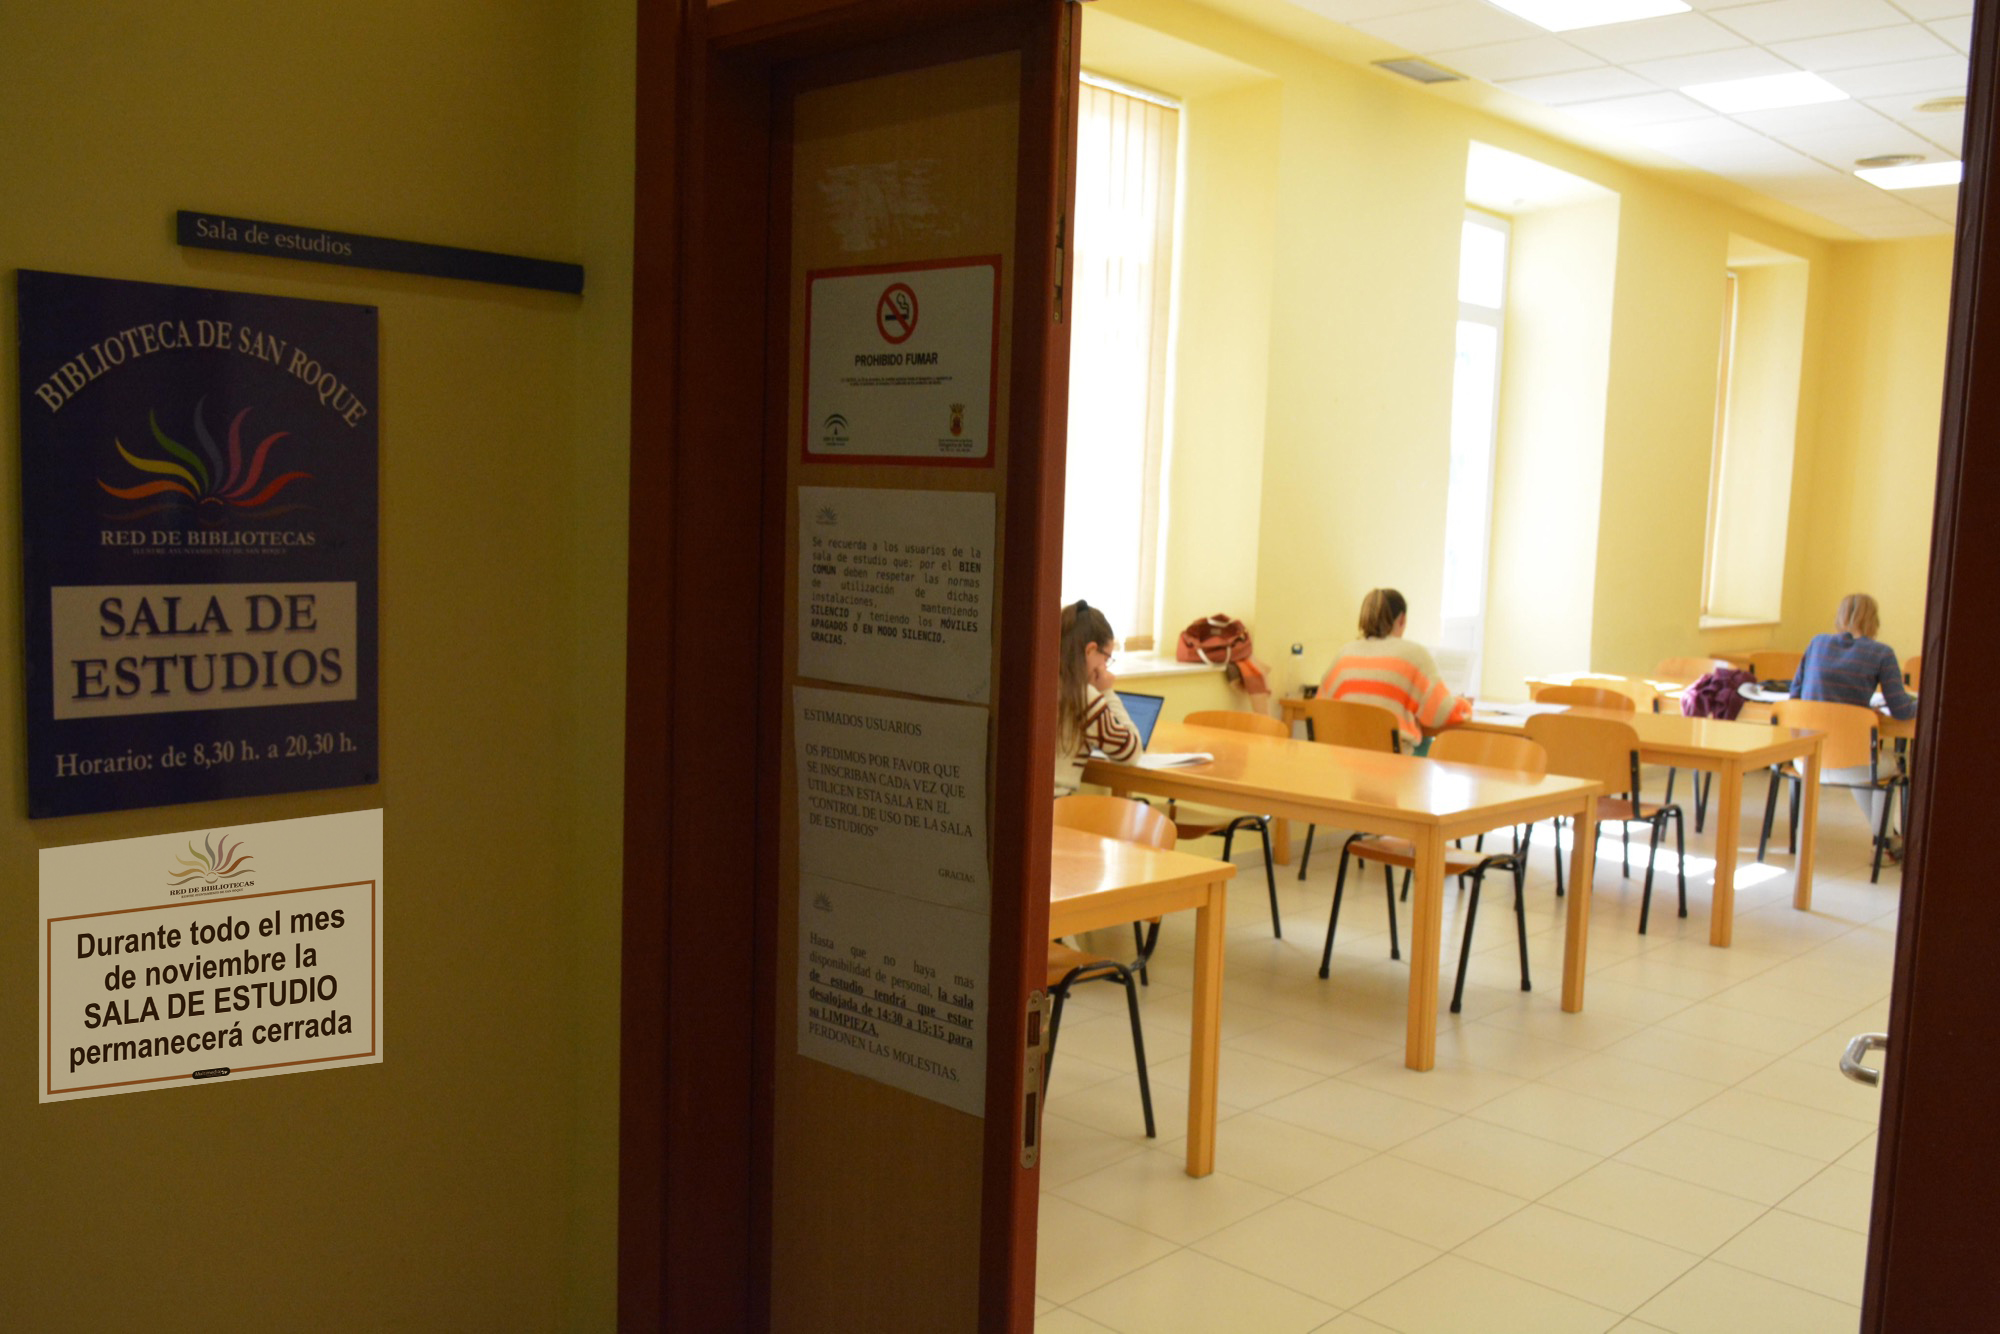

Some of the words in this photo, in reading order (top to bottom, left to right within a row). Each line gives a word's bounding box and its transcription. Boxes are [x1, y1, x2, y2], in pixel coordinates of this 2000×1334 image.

[196, 218, 237, 241] Sala
[245, 225, 269, 245] de
[275, 226, 352, 256] estudios
[35, 319, 193, 413] BIBLIOTECA
[199, 319, 233, 349] DE
[239, 326, 286, 365] SAN
[288, 348, 367, 427] ROQUE
[855, 354, 903, 366] PROHIBIDO
[906, 353, 938, 365] FUMAR
[101, 531, 146, 545] RED
[152, 531, 181, 545] DE
[187, 531, 316, 546] BIBLIOTECAS
[813, 537, 822, 546] Se
[829, 539, 866, 550] recuerda
[884, 541, 898, 553] los
[905, 544, 945, 556] usuarios
[952, 547, 963, 558] de
[971, 547, 980, 558] la
[812, 552, 831, 561] sala
[837, 553, 847, 562] de
[853, 554, 887, 565] estudio
[920, 561, 935, 570] por
[942, 560, 951, 570] el
[959, 562, 981, 573] BIEN
[844, 568, 867, 578] deben
[876, 570, 915, 582] respetar
[924, 573, 939, 584] las
[948, 576, 979, 588] normas
[812, 578, 821, 588] de
[841, 580, 894, 594] utilización
[915, 588, 926, 598] de
[947, 591, 979, 603] dichas
[99, 596, 232, 638] SALA
[246, 593, 317, 633] DE
[811, 606, 849, 617] SILENCIO
[857, 612, 862, 621] y
[870, 611, 909, 624] teniendo
[918, 616, 932, 627] los
[921, 603, 978, 617] manteniendo
[811, 619, 848, 631] APAGADOS
[853, 624, 857, 632] O
[863, 624, 872, 634] EN
[878, 626, 897, 637] MODO
[902, 628, 946, 643] SILENCIO.
[811, 632, 846, 645] GRACIAS.
[71, 646, 342, 700] ESTUDIOS
[804, 709, 863, 727] ESTIMADOS
[865, 718, 921, 736] USUARIOS
[56, 750, 153, 778] Horario:
[161, 746, 186, 769] de
[194, 741, 234, 767] 8,30
[241, 739, 260, 761] h.
[268, 744, 279, 759] a
[285, 733, 334, 760] 20,30
[340, 732, 357, 753] h.
[805, 744, 818, 756] OS
[821, 746, 866, 764] PEDIMOS
[869, 754, 889, 768] POR
[893, 757, 930, 774] FAVOR
[933, 763, 960, 778] QUE
[807, 761, 818, 773] SE
[821, 763, 876, 784] INSCRIBAN
[879, 773, 910, 790] CADA
[914, 779, 936, 794] VEZ
[940, 784, 965, 798] QUE
[808, 778, 854, 797] UTILICEN
[857, 789, 882, 803] ESTA
[885, 793, 913, 809] SALA
[917, 799, 932, 811] EN
[937, 801, 950, 814] EL
[810, 813, 821, 825] DE
[863, 806, 876, 819] DE
[880, 810, 900, 824] USO
[905, 815, 920, 827] DE
[924, 817, 938, 831] LA
[940, 821, 972, 837] SALA
[201, 881, 254, 892] BIBLIOTECAS
[77, 925, 181, 959] Durante
[190, 916, 250, 945] todo
[259, 911, 281, 937] el
[290, 908, 345, 931] mes
[104, 965, 136, 991] de
[145, 949, 285, 986] noviembre
[295, 944, 317, 968] la
[810, 932, 834, 949] Hasta
[850, 946, 866, 958] que
[884, 956, 895, 966] no
[914, 960, 935, 978] haya
[810, 951, 870, 978] disponibilidad
[875, 969, 886, 982] de
[938, 987, 947, 1000] la
[953, 994, 974, 1009] sala
[810, 968, 820, 981] de
[830, 977, 863, 995] estudio
[875, 989, 906, 1008] tendrá
[918, 1004, 935, 1017] que
[947, 1012, 974, 1027] estar
[84, 996, 159, 1029] SALA
[168, 991, 204, 1019] DE
[214, 975, 337, 1013] ESTUDIO
[810, 986, 858, 1012] desalojada
[861, 1002, 872, 1014] de
[907, 1019, 912, 1029] a
[949, 1032, 973, 1049] para
[70, 1021, 242, 1073] permanecerá
[252, 1010, 352, 1044] cerrada
[809, 1021, 865, 1049] PERDONEN
[869, 1041, 889, 1057] LAS
[893, 1049, 959, 1082] MOLESTIAS.
